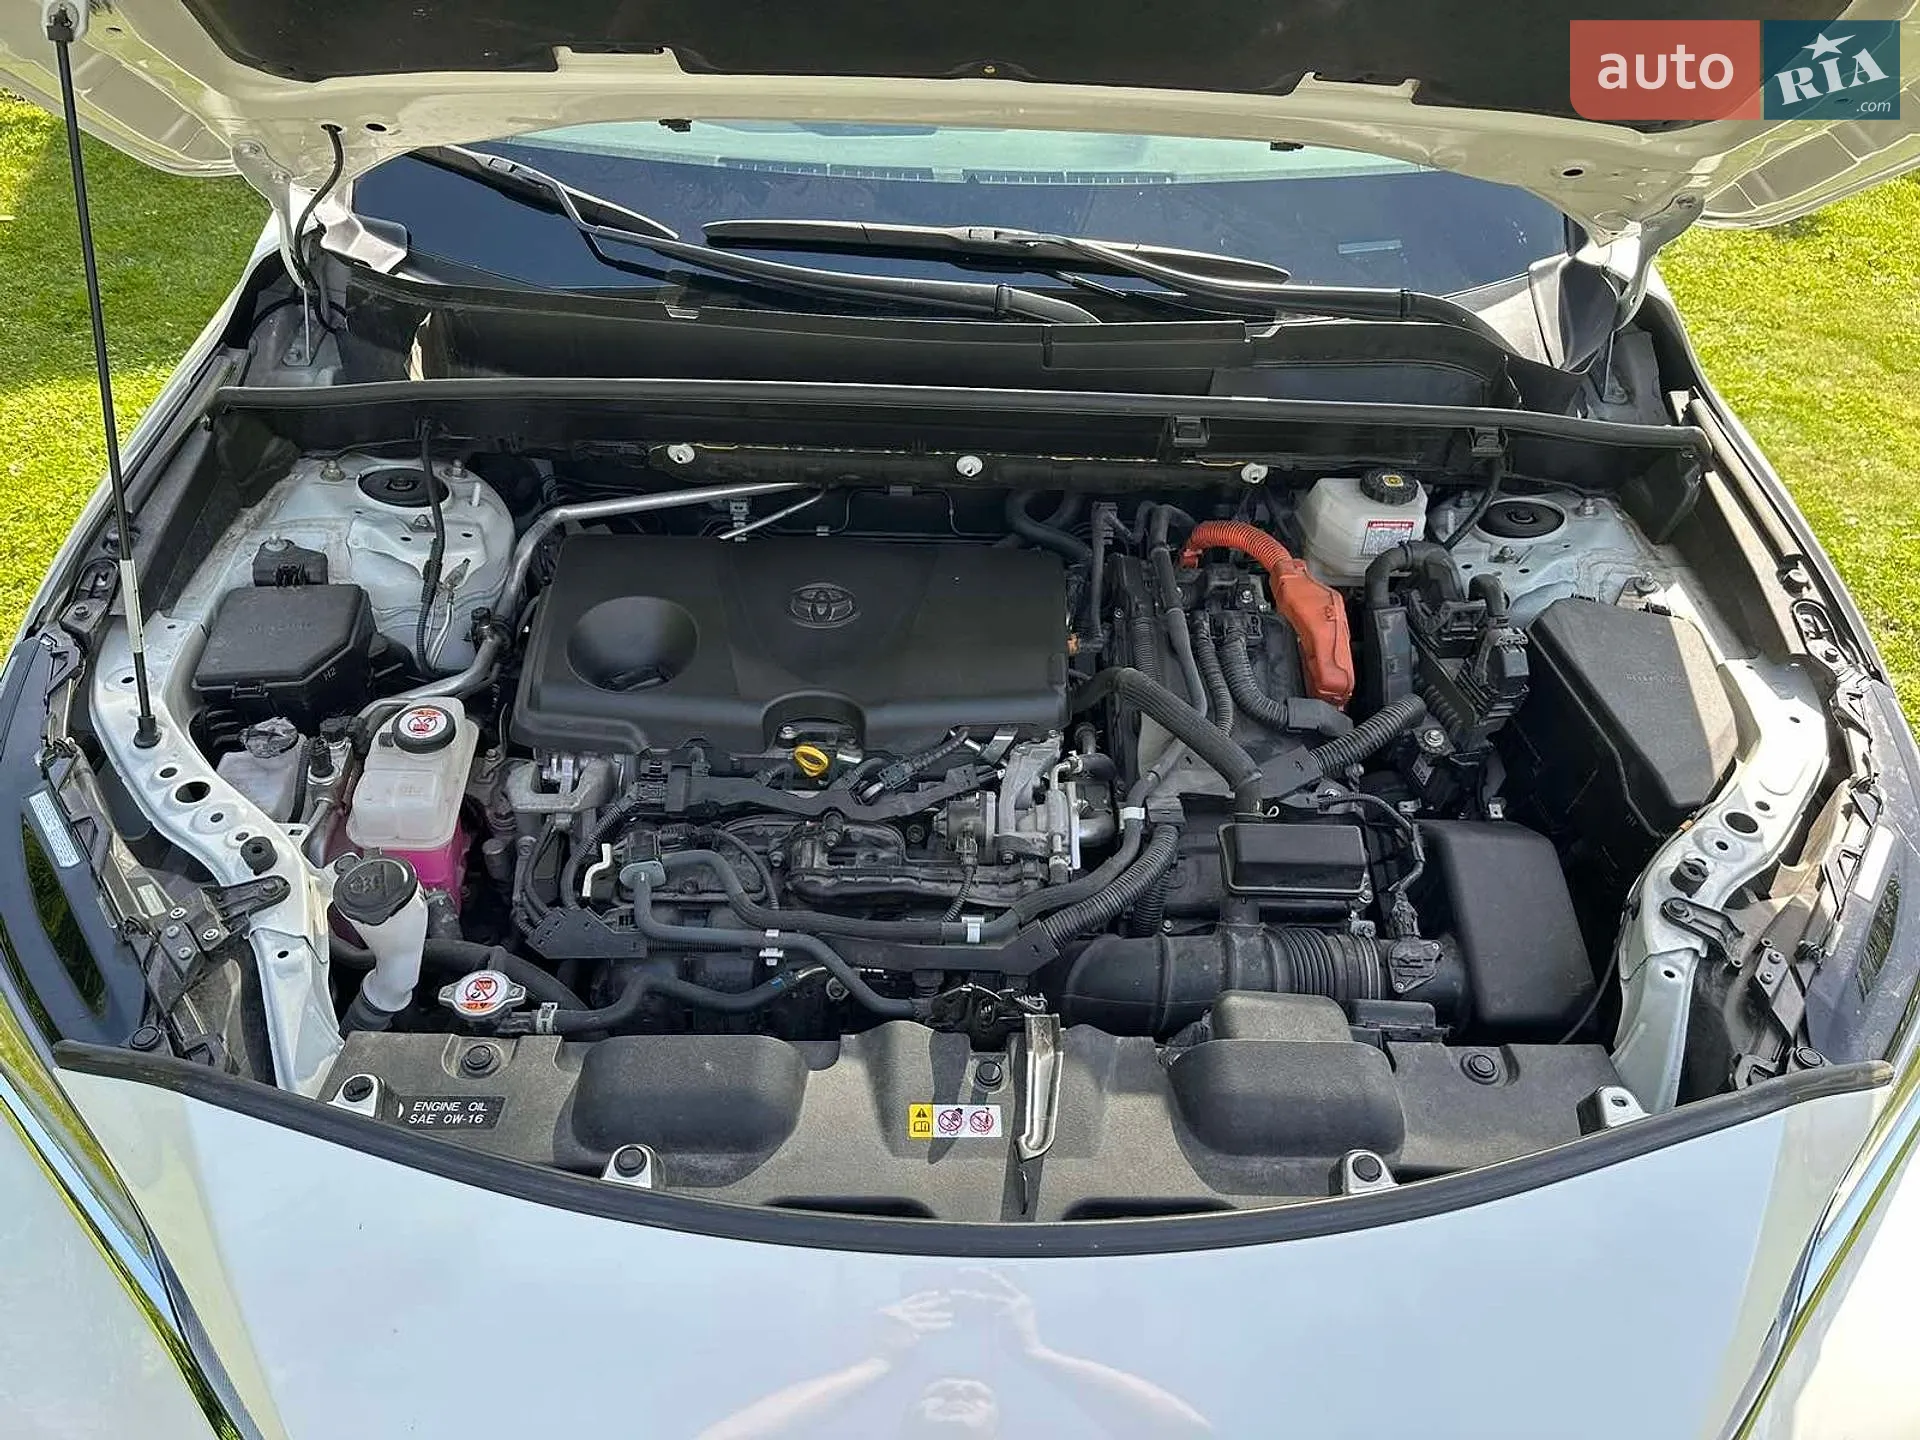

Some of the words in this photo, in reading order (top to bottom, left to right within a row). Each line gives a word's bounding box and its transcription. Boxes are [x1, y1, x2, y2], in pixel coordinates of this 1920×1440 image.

[413, 1101, 461, 1112] ENGINE
[468, 1101, 488, 1112] OIL
[408, 1113, 437, 1124] SAE
[443, 1113, 485, 1124] 0W-16
